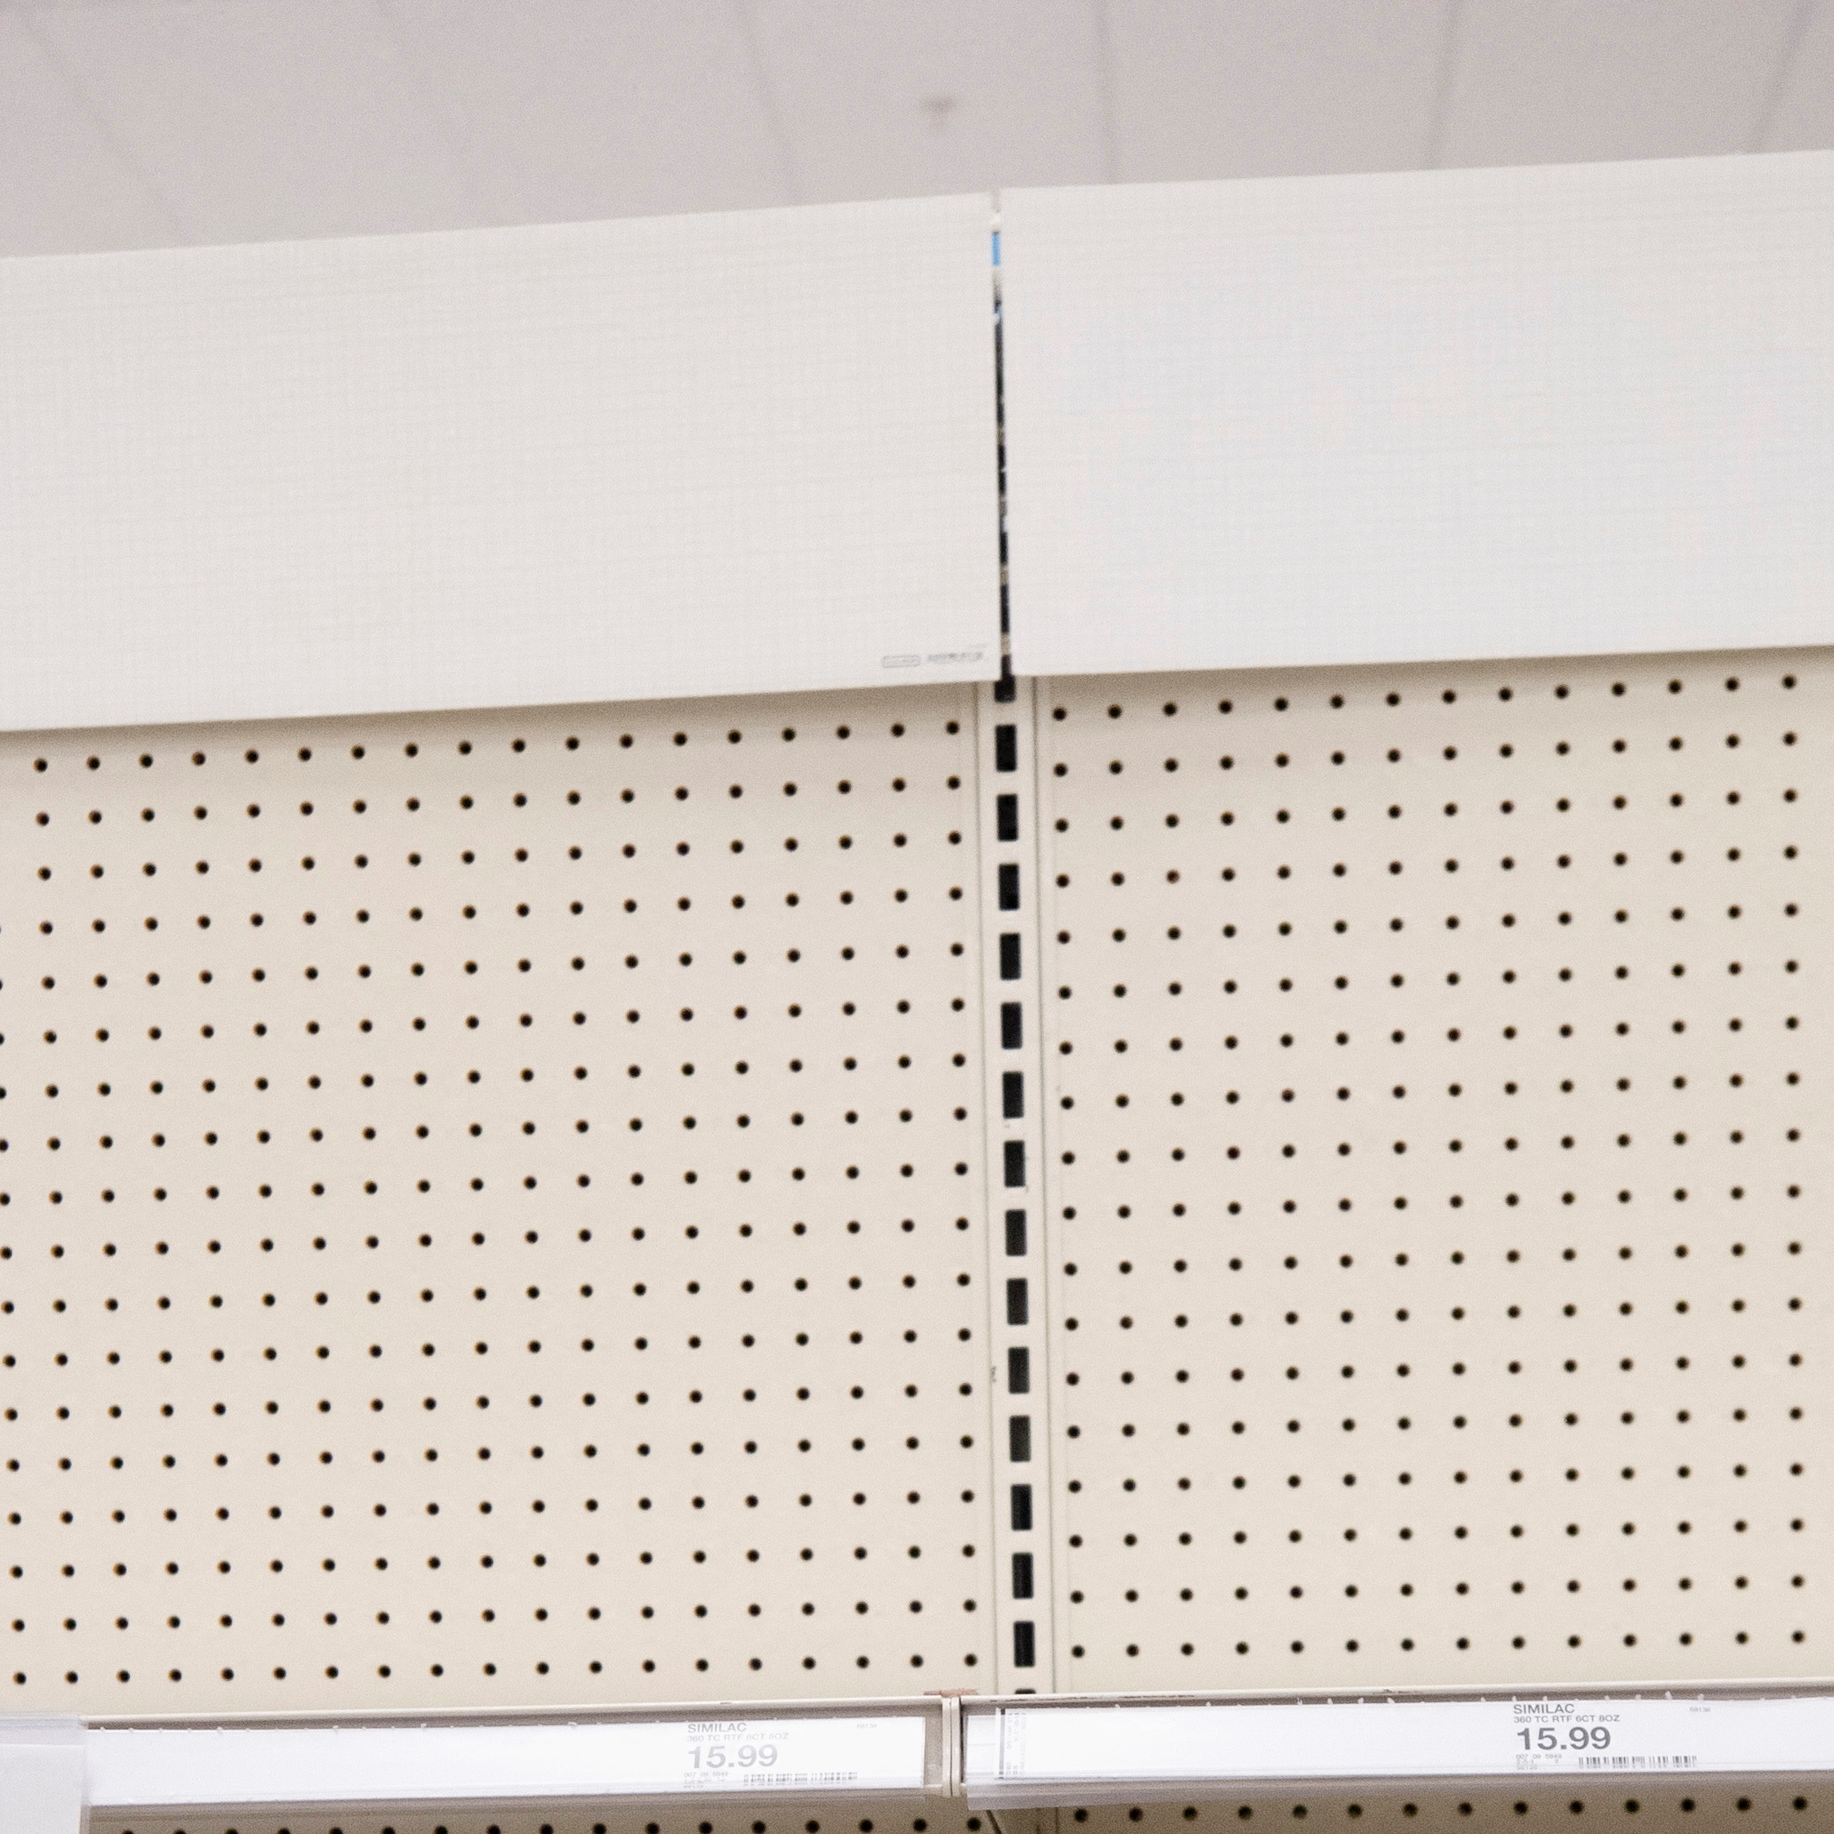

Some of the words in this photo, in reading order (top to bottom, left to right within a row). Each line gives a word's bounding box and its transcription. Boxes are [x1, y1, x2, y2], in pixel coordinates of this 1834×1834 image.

[1513, 1704, 1575, 1714] SIMILAC
[1514, 1715, 1531, 1724] 360
[1535, 1715, 1549, 1723] TC
[1553, 1715, 1572, 1723] RTF
[1575, 1714, 1595, 1723] 6CT
[687, 1722, 747, 1733] SIMILAC
[1517, 1727, 1611, 1750] 15.99
[687, 1744, 778, 1768] 15.99
